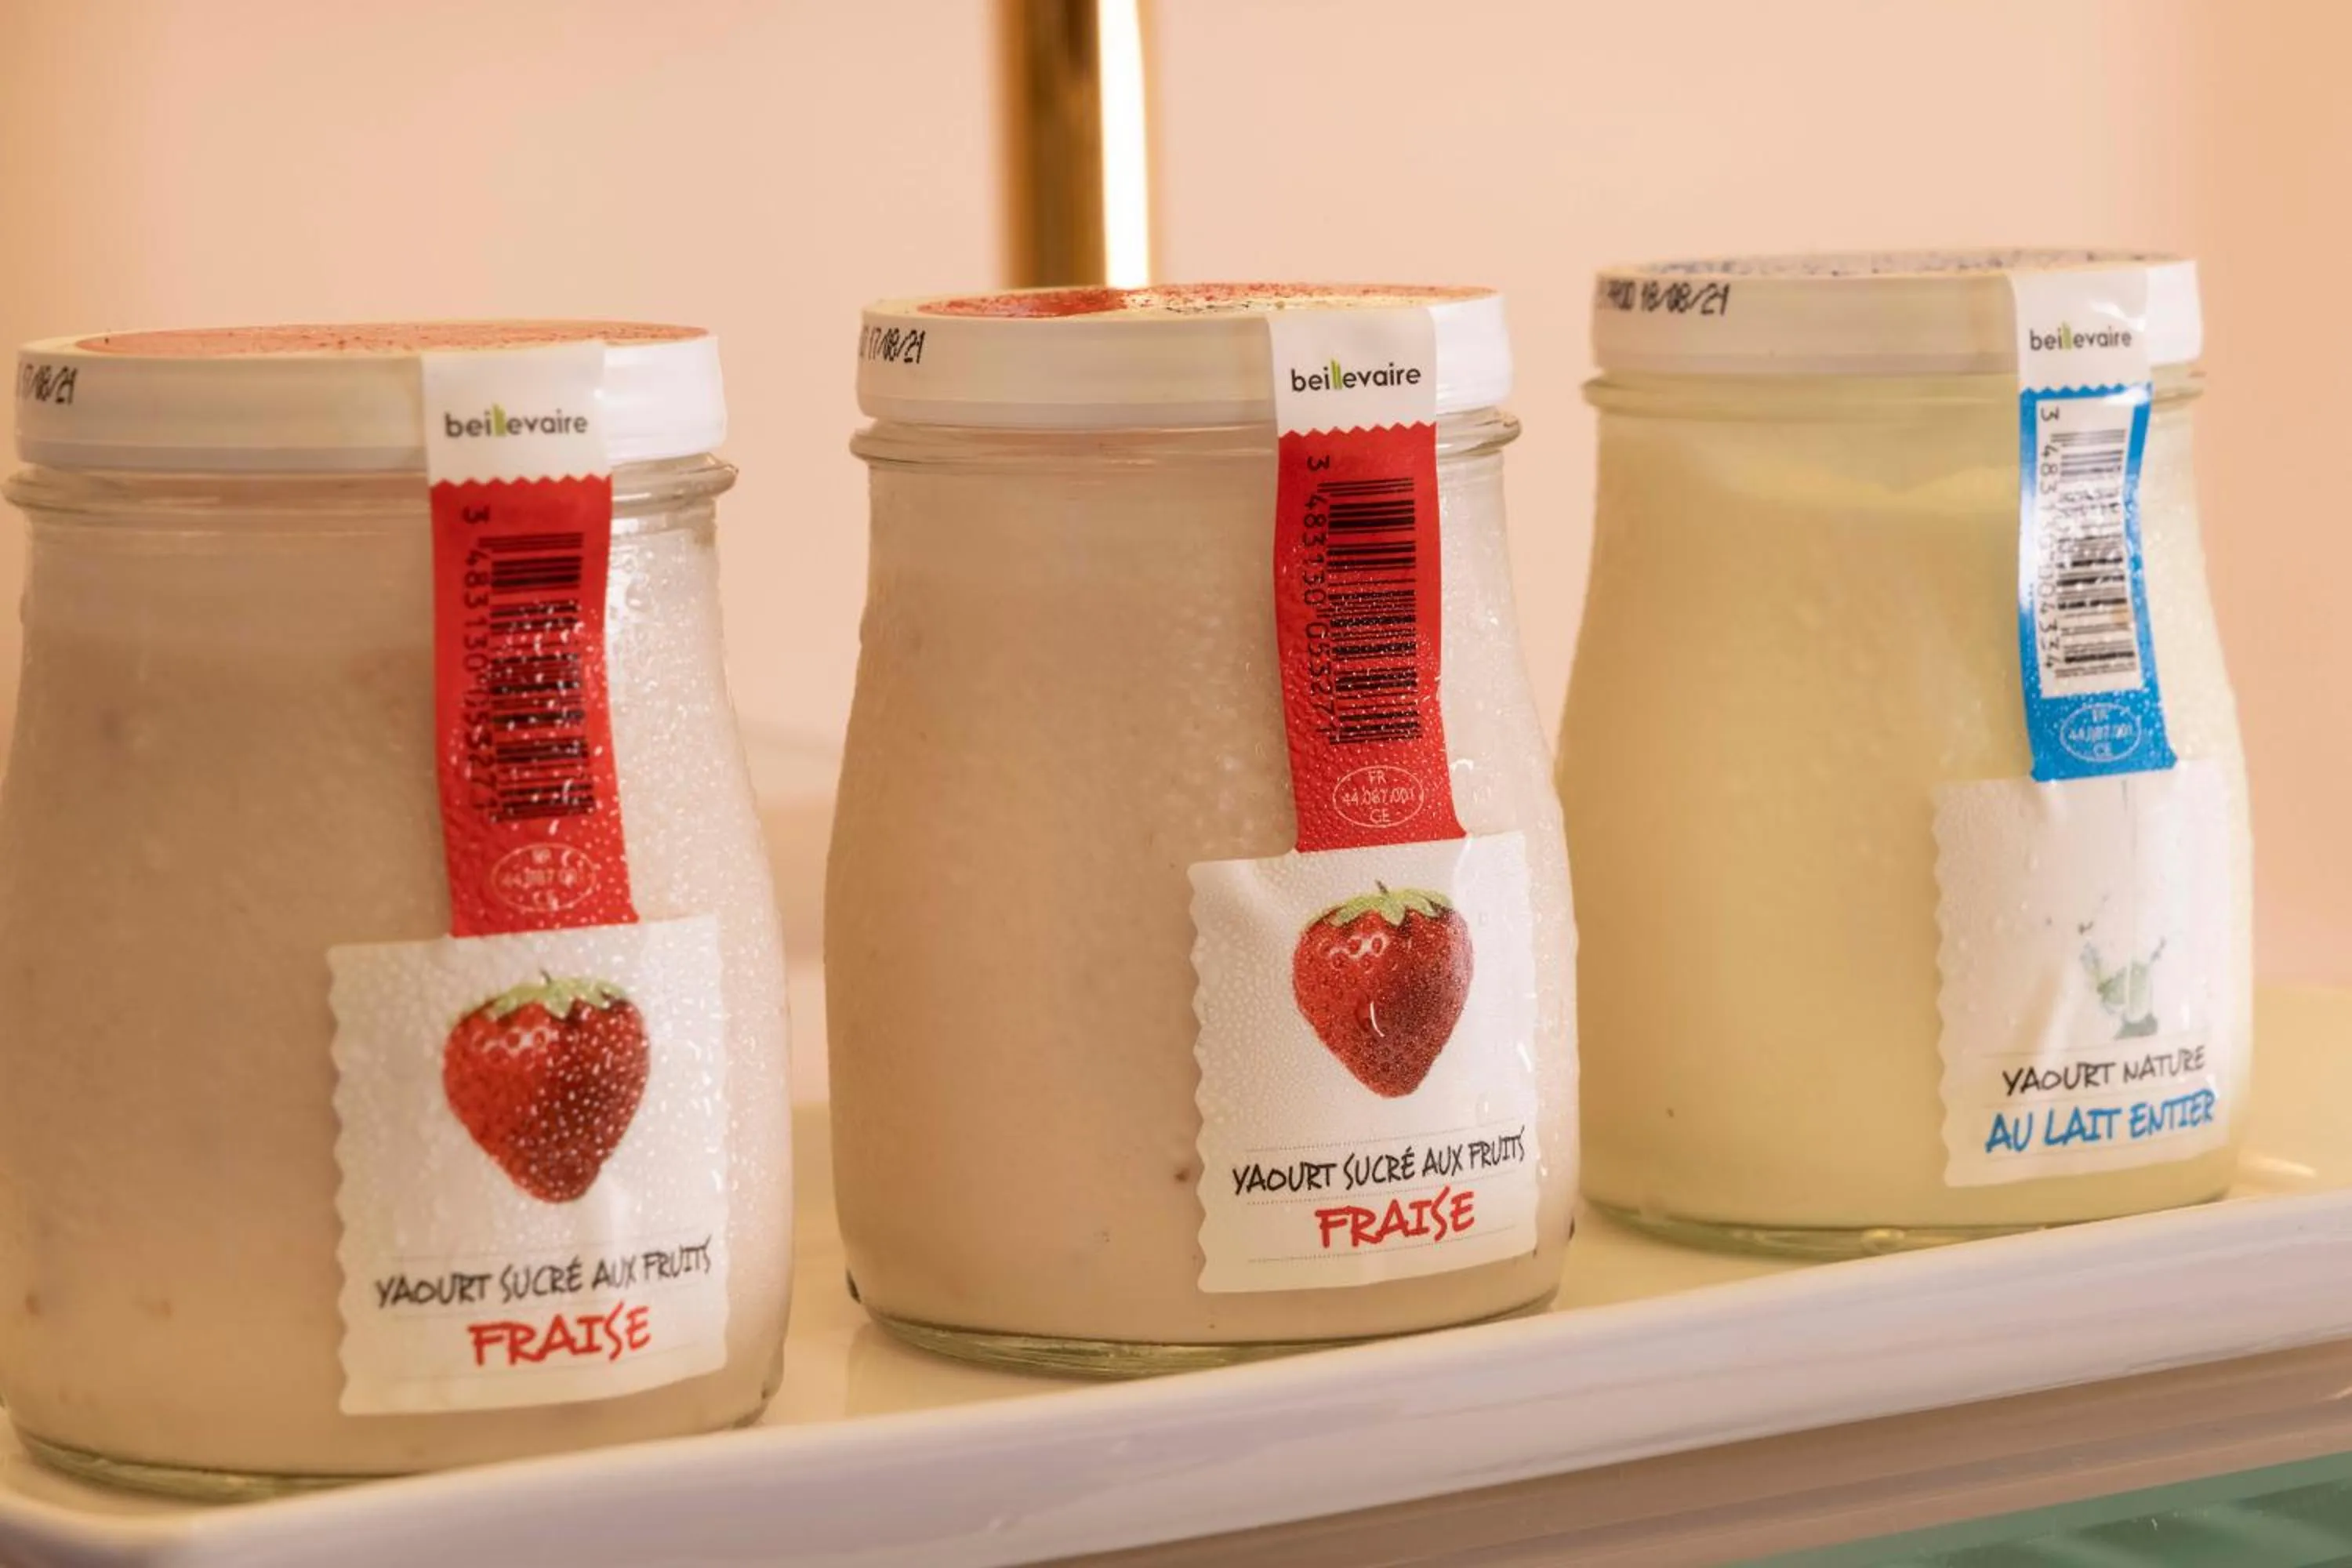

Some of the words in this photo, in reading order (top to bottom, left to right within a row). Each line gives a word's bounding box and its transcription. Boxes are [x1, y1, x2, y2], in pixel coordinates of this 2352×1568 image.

[2029, 320, 2132, 351] beillevaire
[1290, 358, 1421, 392] beillevaire
[444, 395, 588, 438] beillevaire
[2040, 406, 2060, 421] 3
[1306, 454, 1330, 471] 3
[463, 504, 490, 524] 3
[1302, 494, 1328, 605] 483130
[463, 550, 490, 673] 483130
[1367, 769, 1388, 785] FR
[2002, 1061, 2117, 1097] YAOURT
[2122, 1045, 2206, 1083] NATURE
[1984, 1109, 2034, 1154] AU
[2042, 1104, 2122, 1147] LAIT
[2127, 1087, 2217, 1140] ENTIER
[1232, 1162, 1338, 1196] YAOURT
[1342, 1145, 1416, 1191] SUCRÉ
[1421, 1146, 1464, 1178] AUX
[1468, 1125, 1526, 1170] FRUITS
[1314, 1185, 1475, 1248] FRAISE
[375, 1273, 493, 1308] YAOURT
[499, 1255, 583, 1304] SUCRÉ
[590, 1259, 636, 1290] AUX
[643, 1235, 713, 1283] FRUITS
[467, 1301, 652, 1367] FRAISE
